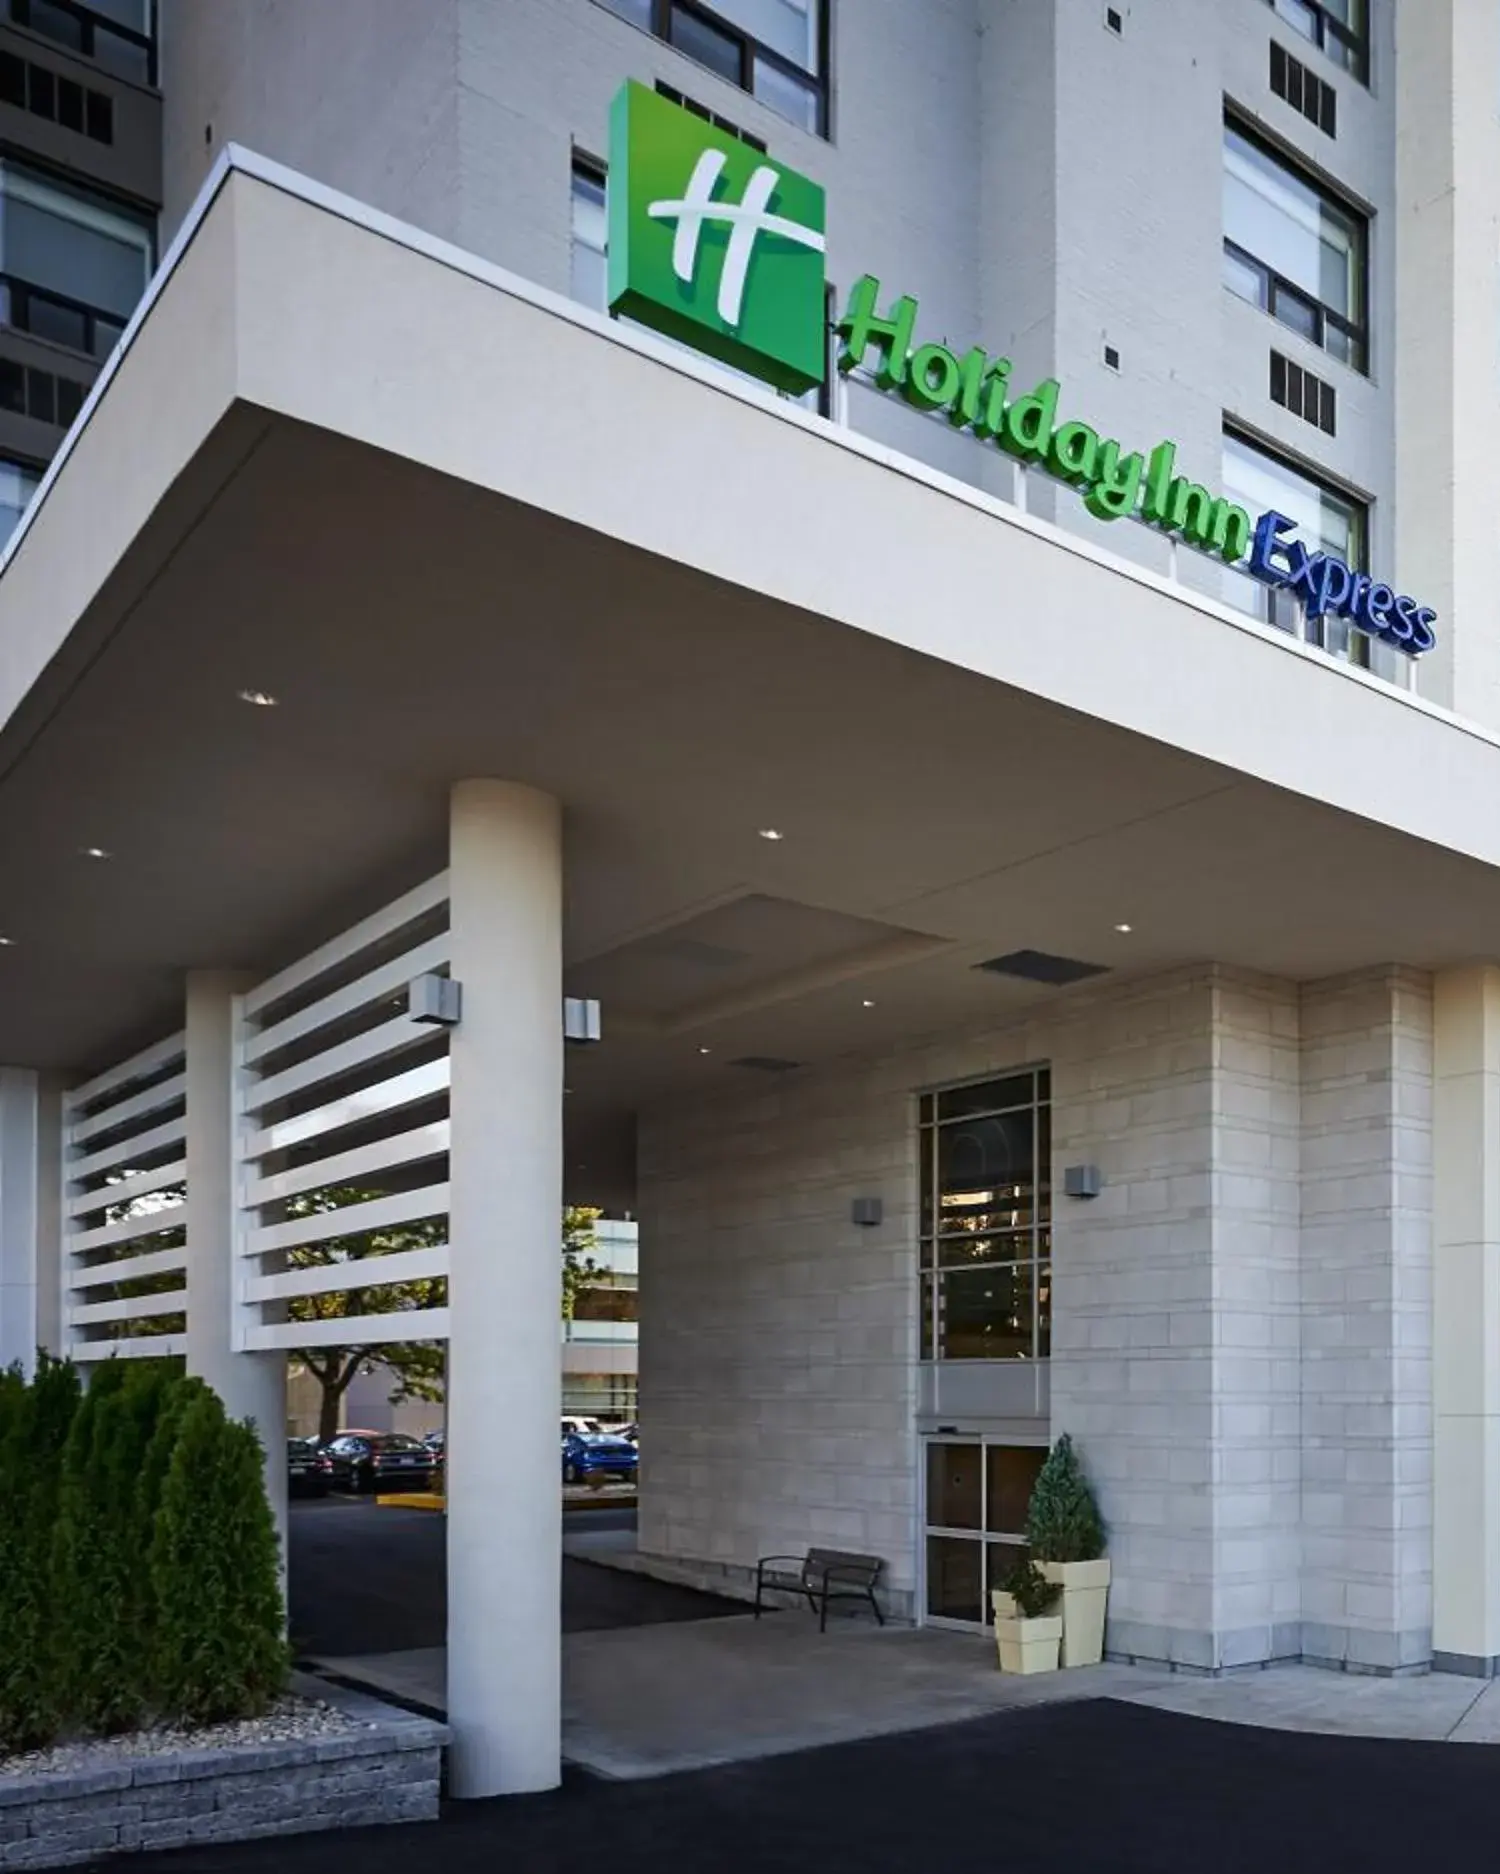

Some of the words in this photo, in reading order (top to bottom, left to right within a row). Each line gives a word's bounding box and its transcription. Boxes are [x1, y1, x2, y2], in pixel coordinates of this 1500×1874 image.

[836, 273, 1144, 521] Holiday
[1142, 440, 1250, 562] Inn
[1250, 509, 1437, 653] Express
